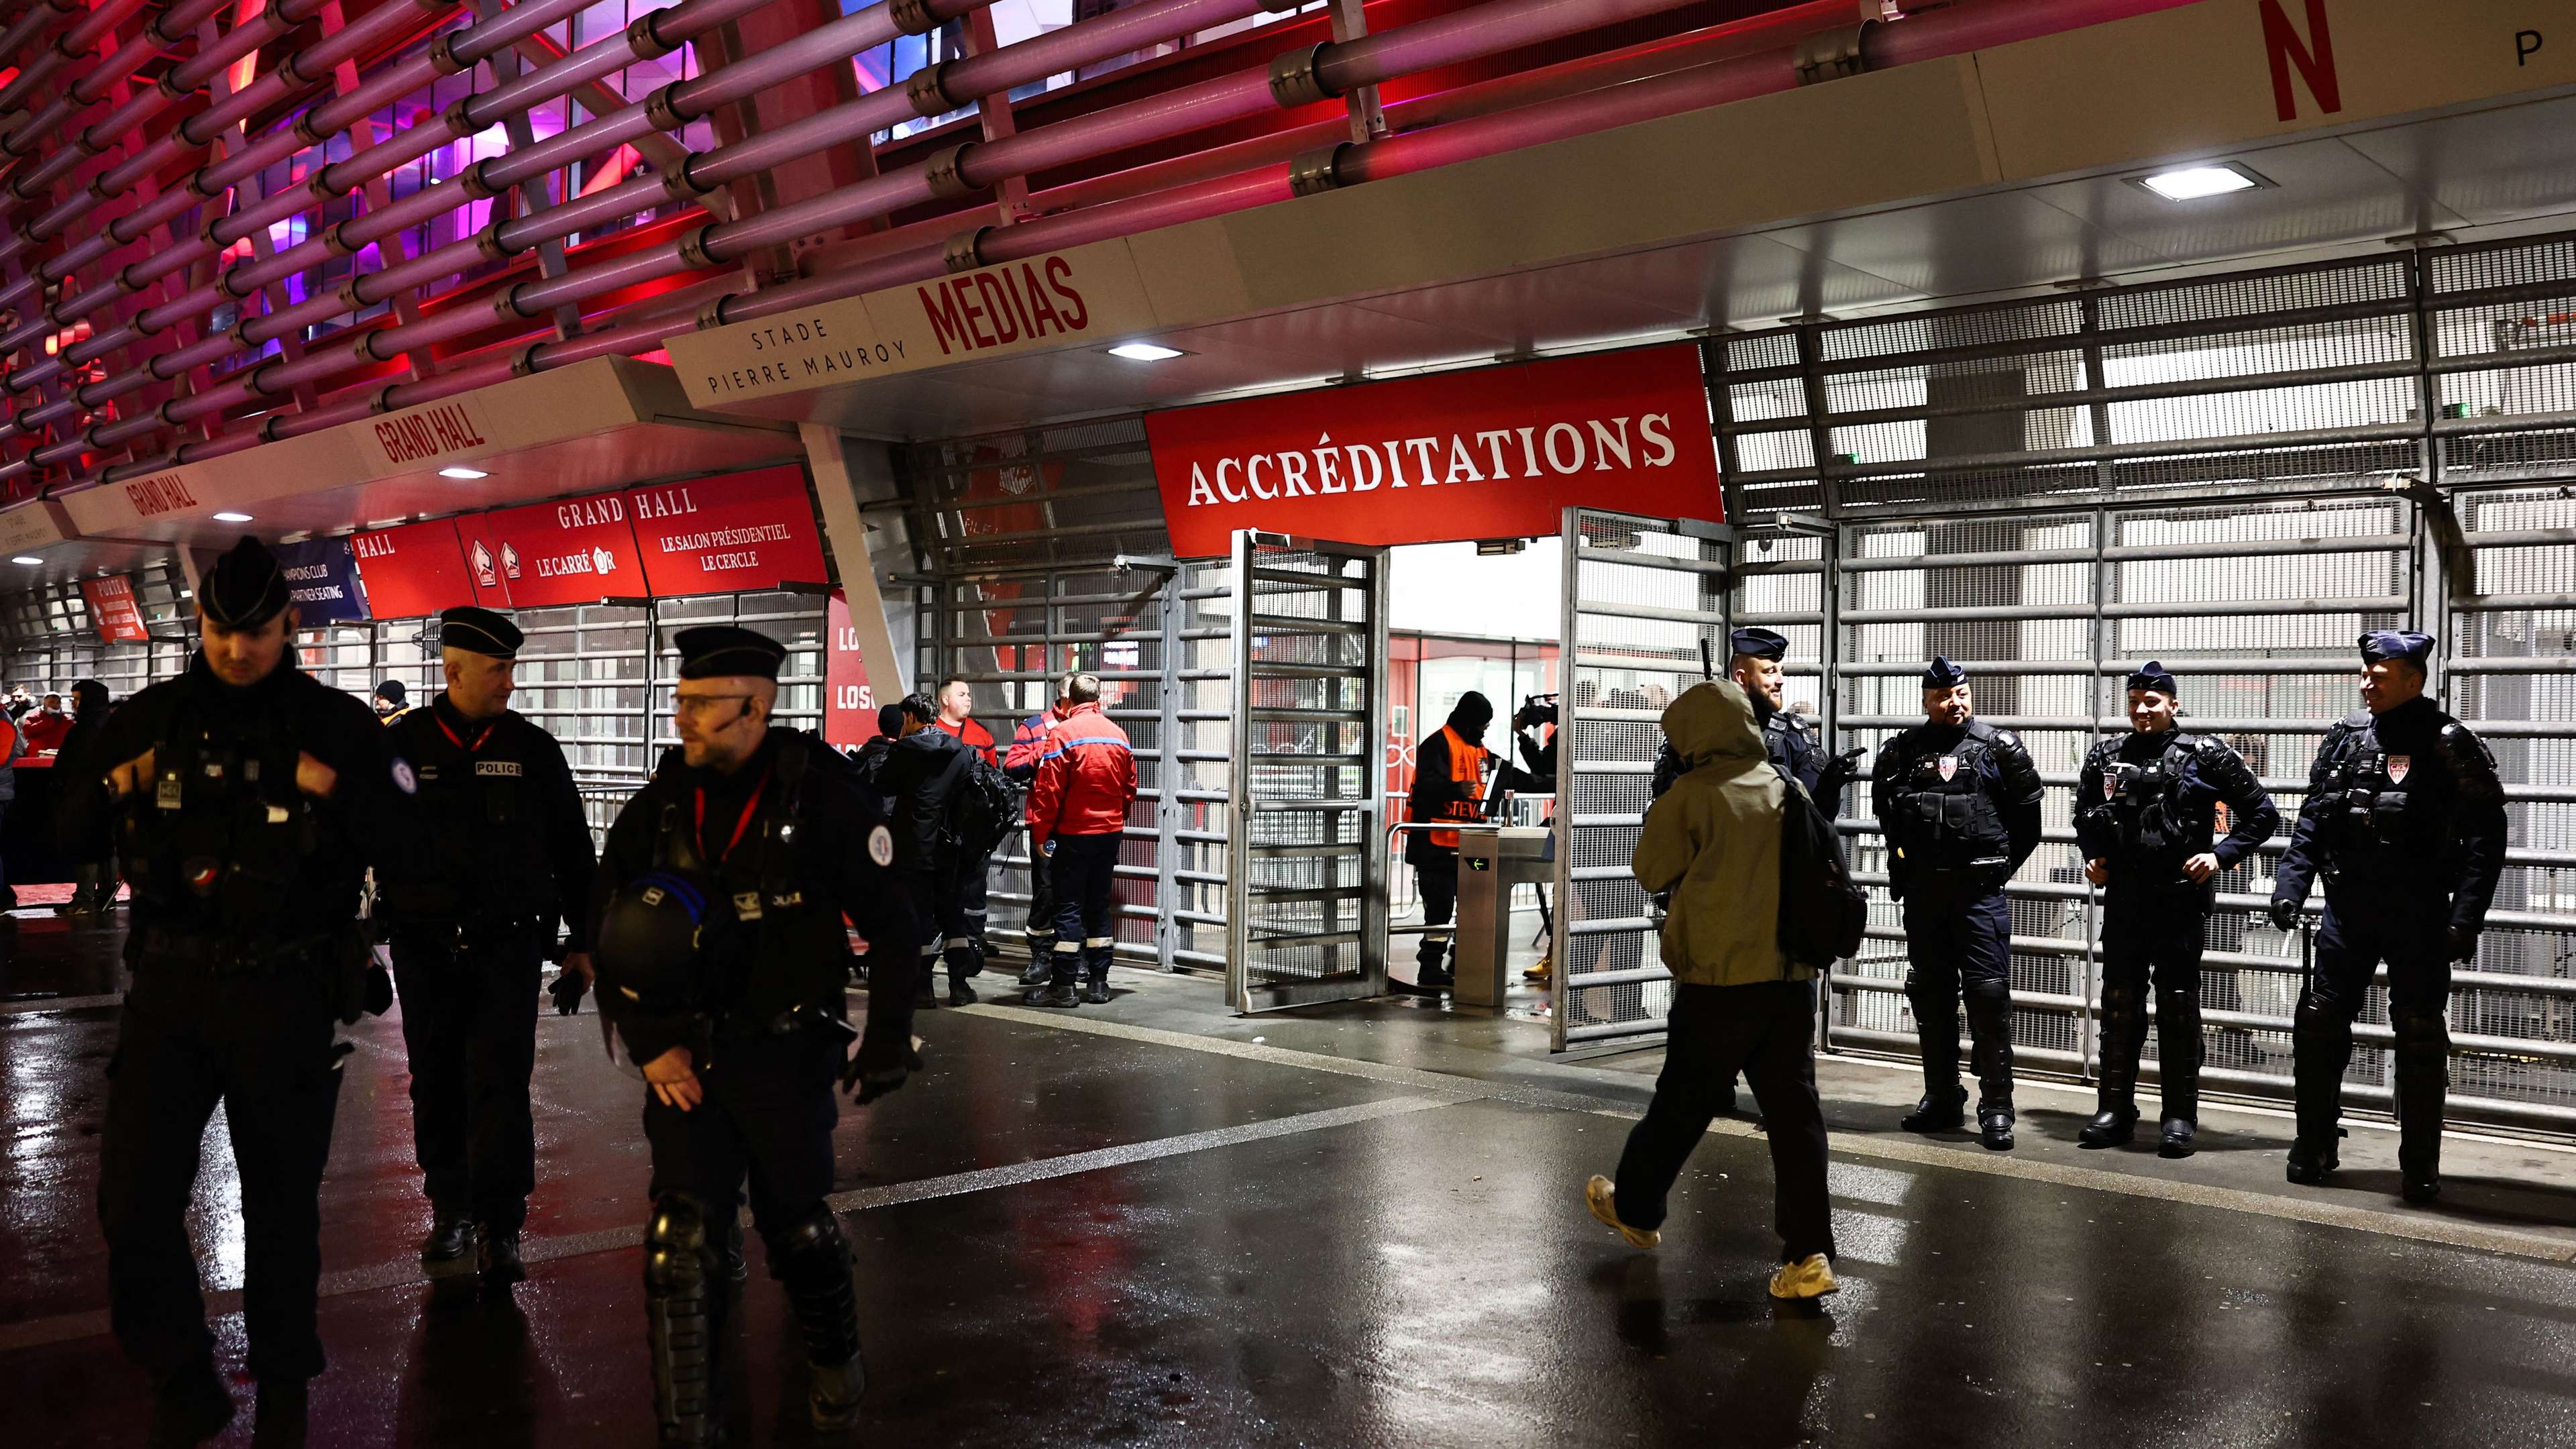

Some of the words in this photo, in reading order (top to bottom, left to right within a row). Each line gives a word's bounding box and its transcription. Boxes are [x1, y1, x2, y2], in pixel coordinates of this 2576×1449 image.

[2259, 0, 2341, 122] N
[2515, 30, 2543, 66] P
[918, 256, 1088, 355] MEDIAS
[751, 319, 828, 350] STADE
[708, 362, 790, 394] PIERRE
[805, 340, 907, 376] MAUROY
[374, 415, 439, 464] GRAND
[427, 403, 485, 452] HALL
[1187, 412, 1676, 506] ACCRÉDITATIONS
[126, 480, 169, 516] GRAND
[157, 474, 197, 509] HALL
[557, 497, 623, 529] GRAND
[635, 488, 698, 519] HALL
[356, 534, 396, 558] HALL
[660, 536, 676, 553] LE
[676, 533, 711, 551] SALON
[710, 523, 791, 547] PRÉSIDENTIEL
[310, 564, 328, 578] CLUB
[536, 559, 553, 577] LE
[552, 549, 592, 576] CARRÉ
[700, 555, 716, 572] LE
[716, 551, 759, 570] CERCLE
[315, 585, 343, 600] SEATING
[839, 627, 859, 651] LO
[837, 686, 876, 710] LOS
[477, 763, 521, 774] POLICE
